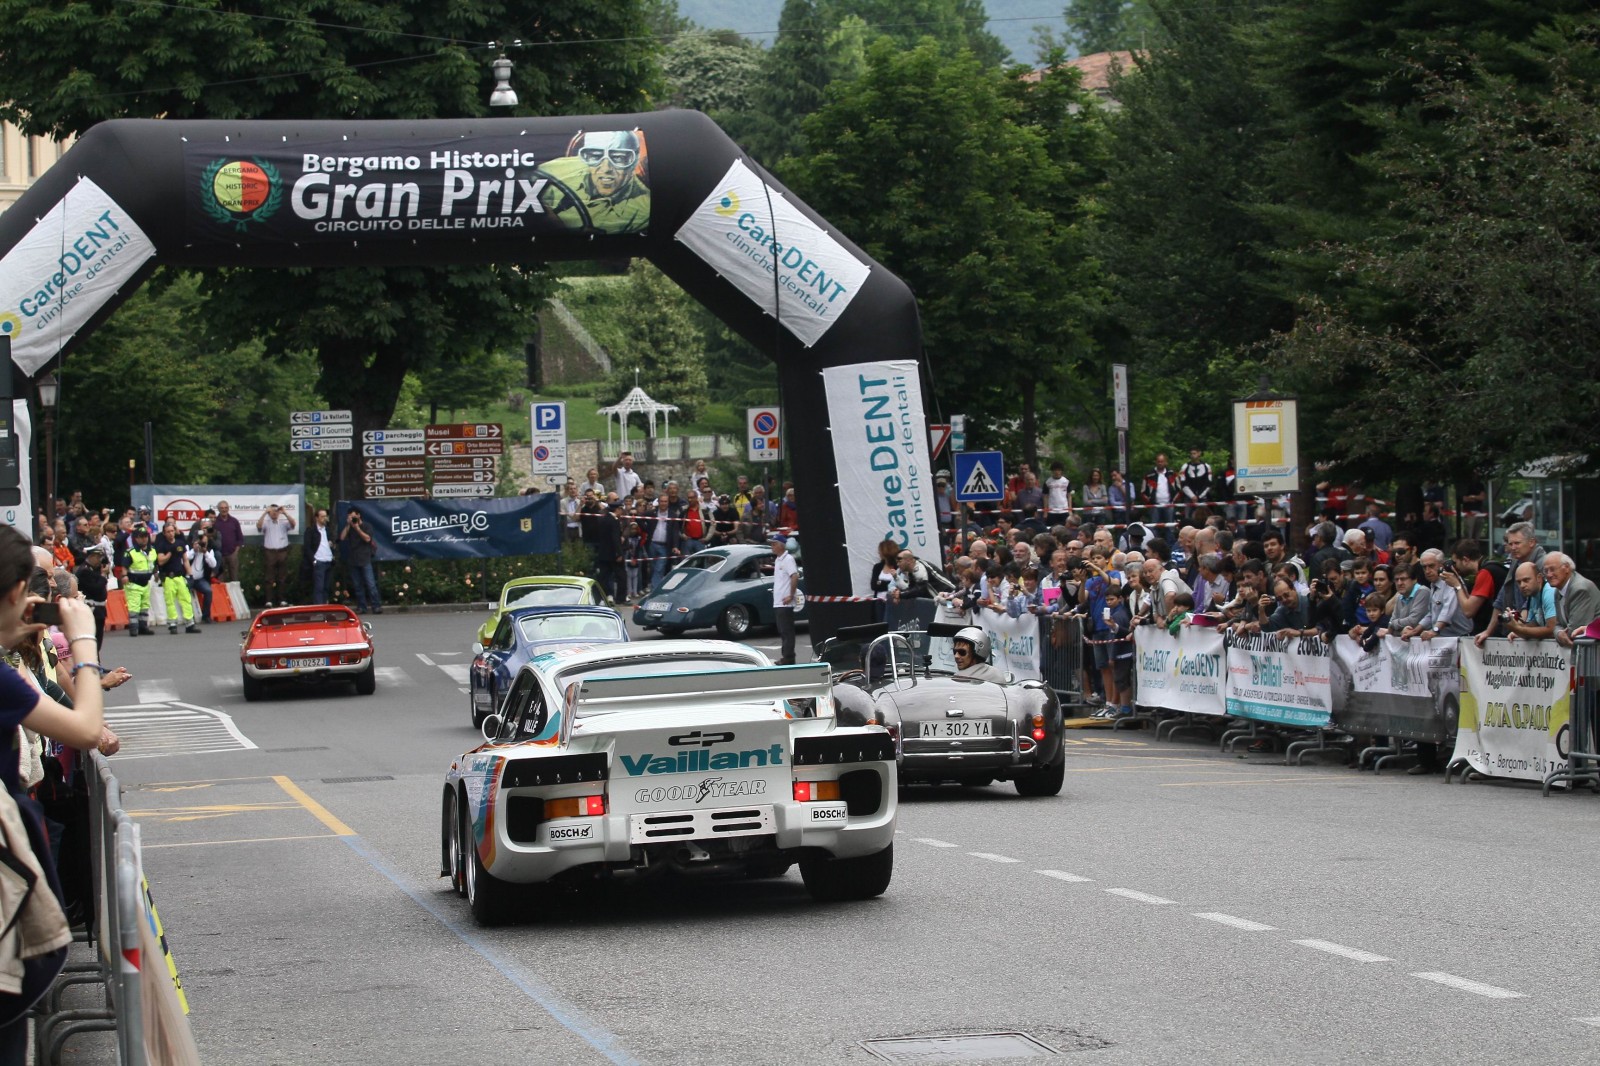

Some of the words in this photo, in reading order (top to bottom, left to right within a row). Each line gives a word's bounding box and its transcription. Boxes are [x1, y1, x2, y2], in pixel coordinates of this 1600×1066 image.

[302, 153, 420, 177] Bergamo
[430, 149, 535, 169] Historic
[291, 172, 420, 220] Gran
[440, 168, 548, 216] Prix
[314, 220, 403, 232] CIRCUITO
[408, 218, 466, 230] DELLE
[470, 216, 524, 229] MURA
[19, 210, 120, 317] CareDENT
[737, 212, 848, 304] CareDENT
[37, 281, 84, 331] cliniche
[86, 231, 131, 281] dentali
[726, 230, 778, 275] cliniche
[779, 272, 828, 317] dentali
[541, 408, 556, 428] P
[893, 375, 914, 454] dentali
[907, 464, 926, 547] cliniche
[392, 513, 469, 533] EBERHARD
[291, 658, 300, 667] DX
[1142, 650, 1171, 672] CareDENT
[1180, 653, 1220, 678] CareDENT
[1482, 650, 1526, 669] Autoriparazioni
[1180, 681, 1197, 693] cliniche
[1198, 682, 1219, 695] dentali
[1518, 672, 1535, 688] Auto
[923, 723, 938, 737] AY
[946, 722, 969, 736] 302
[974, 722, 990, 736] YA
[619, 744, 784, 777] Vaillant
[1497, 753, 1527, 773] Bergamo
[813, 809, 841, 819] BOSCH
[550, 828, 580, 839] BOSCH
